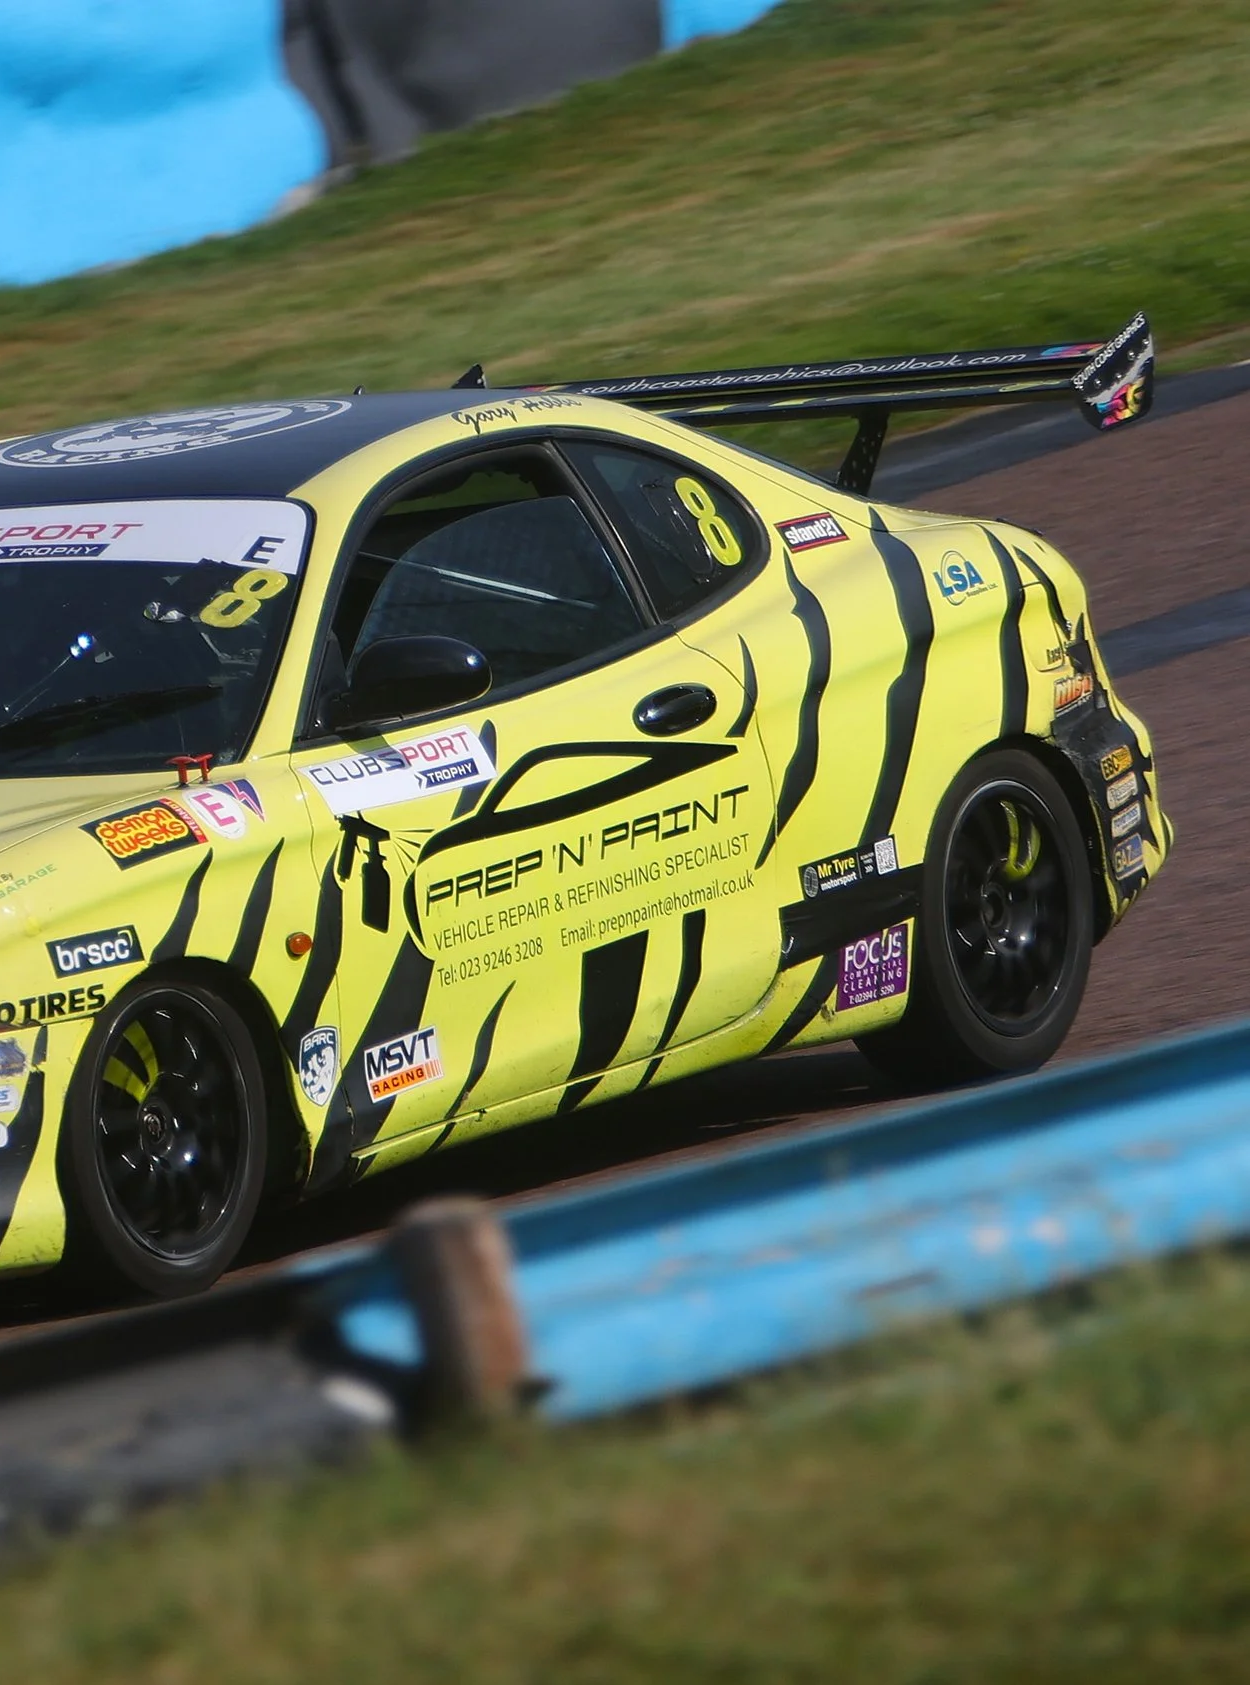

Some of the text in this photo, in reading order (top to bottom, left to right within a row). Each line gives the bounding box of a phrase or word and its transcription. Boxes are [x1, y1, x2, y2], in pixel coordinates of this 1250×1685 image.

[451, 405, 518, 435] Gary
[675, 477, 742, 566] 8
[8, 545, 98, 558] TROPHY
[241, 536, 285, 564] E
[932, 560, 984, 598] LSA
[200, 568, 288, 628] 8
[309, 731, 468, 785] CLUBSPORT
[427, 763, 472, 784] TROPHY
[99, 808, 173, 839] demon
[192, 792, 237, 827] E
[107, 821, 186, 856] tweeks
[425, 785, 748, 917] PREP 'N' PAINT
[0, 871, 14, 884] By
[817, 863, 832, 879] Mr
[832, 857, 855, 876] Tyre
[820, 871, 857, 891] motorsport
[434, 833, 750, 951] VEHICLE REPAIR & REFINISHING SPECIALIST
[560, 870, 754, 948] Email: prepnpaint@hotmail.co.uk
[55, 935, 133, 971] brscc
[437, 936, 543, 988] Tel: 023 9246 3208
[845, 931, 902, 973] FOCUS
[19, 984, 106, 1026] TIRES
[303, 1032, 334, 1051] BARC
[366, 1027, 434, 1081] MSVT
[372, 1067, 425, 1095] RACING
